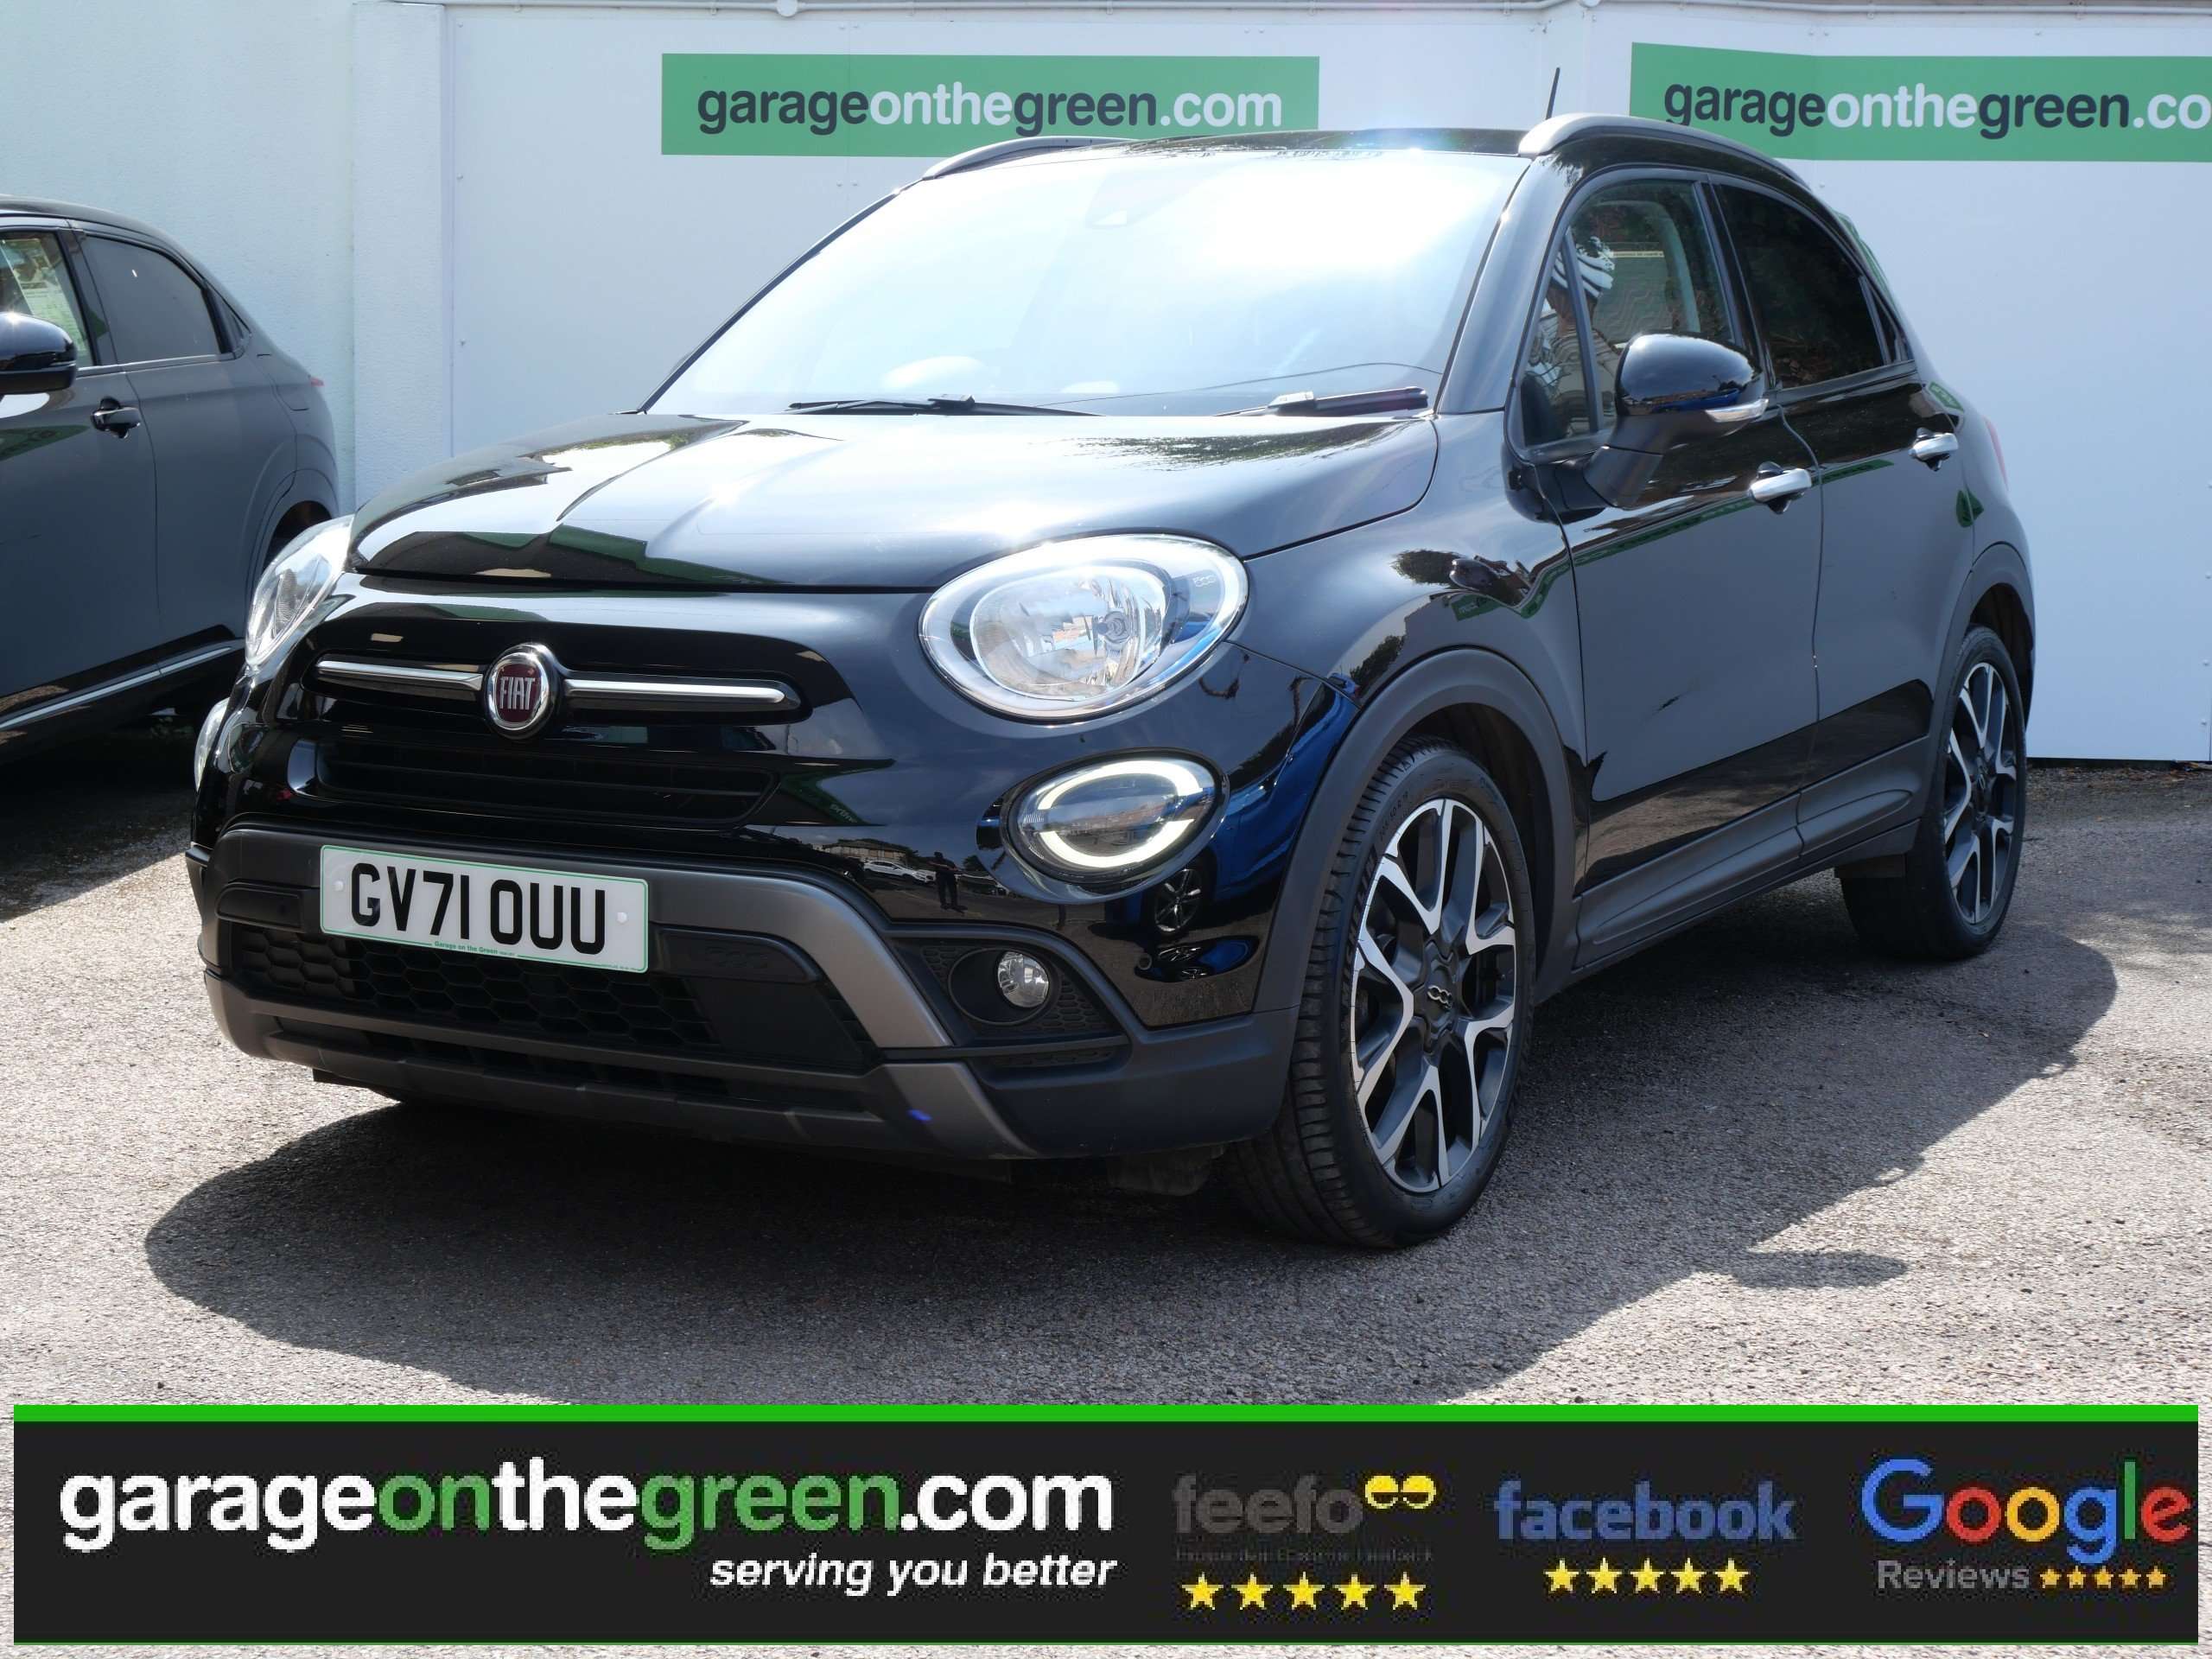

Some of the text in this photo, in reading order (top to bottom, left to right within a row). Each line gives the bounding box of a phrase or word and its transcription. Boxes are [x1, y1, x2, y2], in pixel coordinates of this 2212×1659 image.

[697, 81, 1282, 137] garageonthegreen.com
[499, 676, 536, 710] FIAT
[351, 862, 606, 955] GV71 OUU
